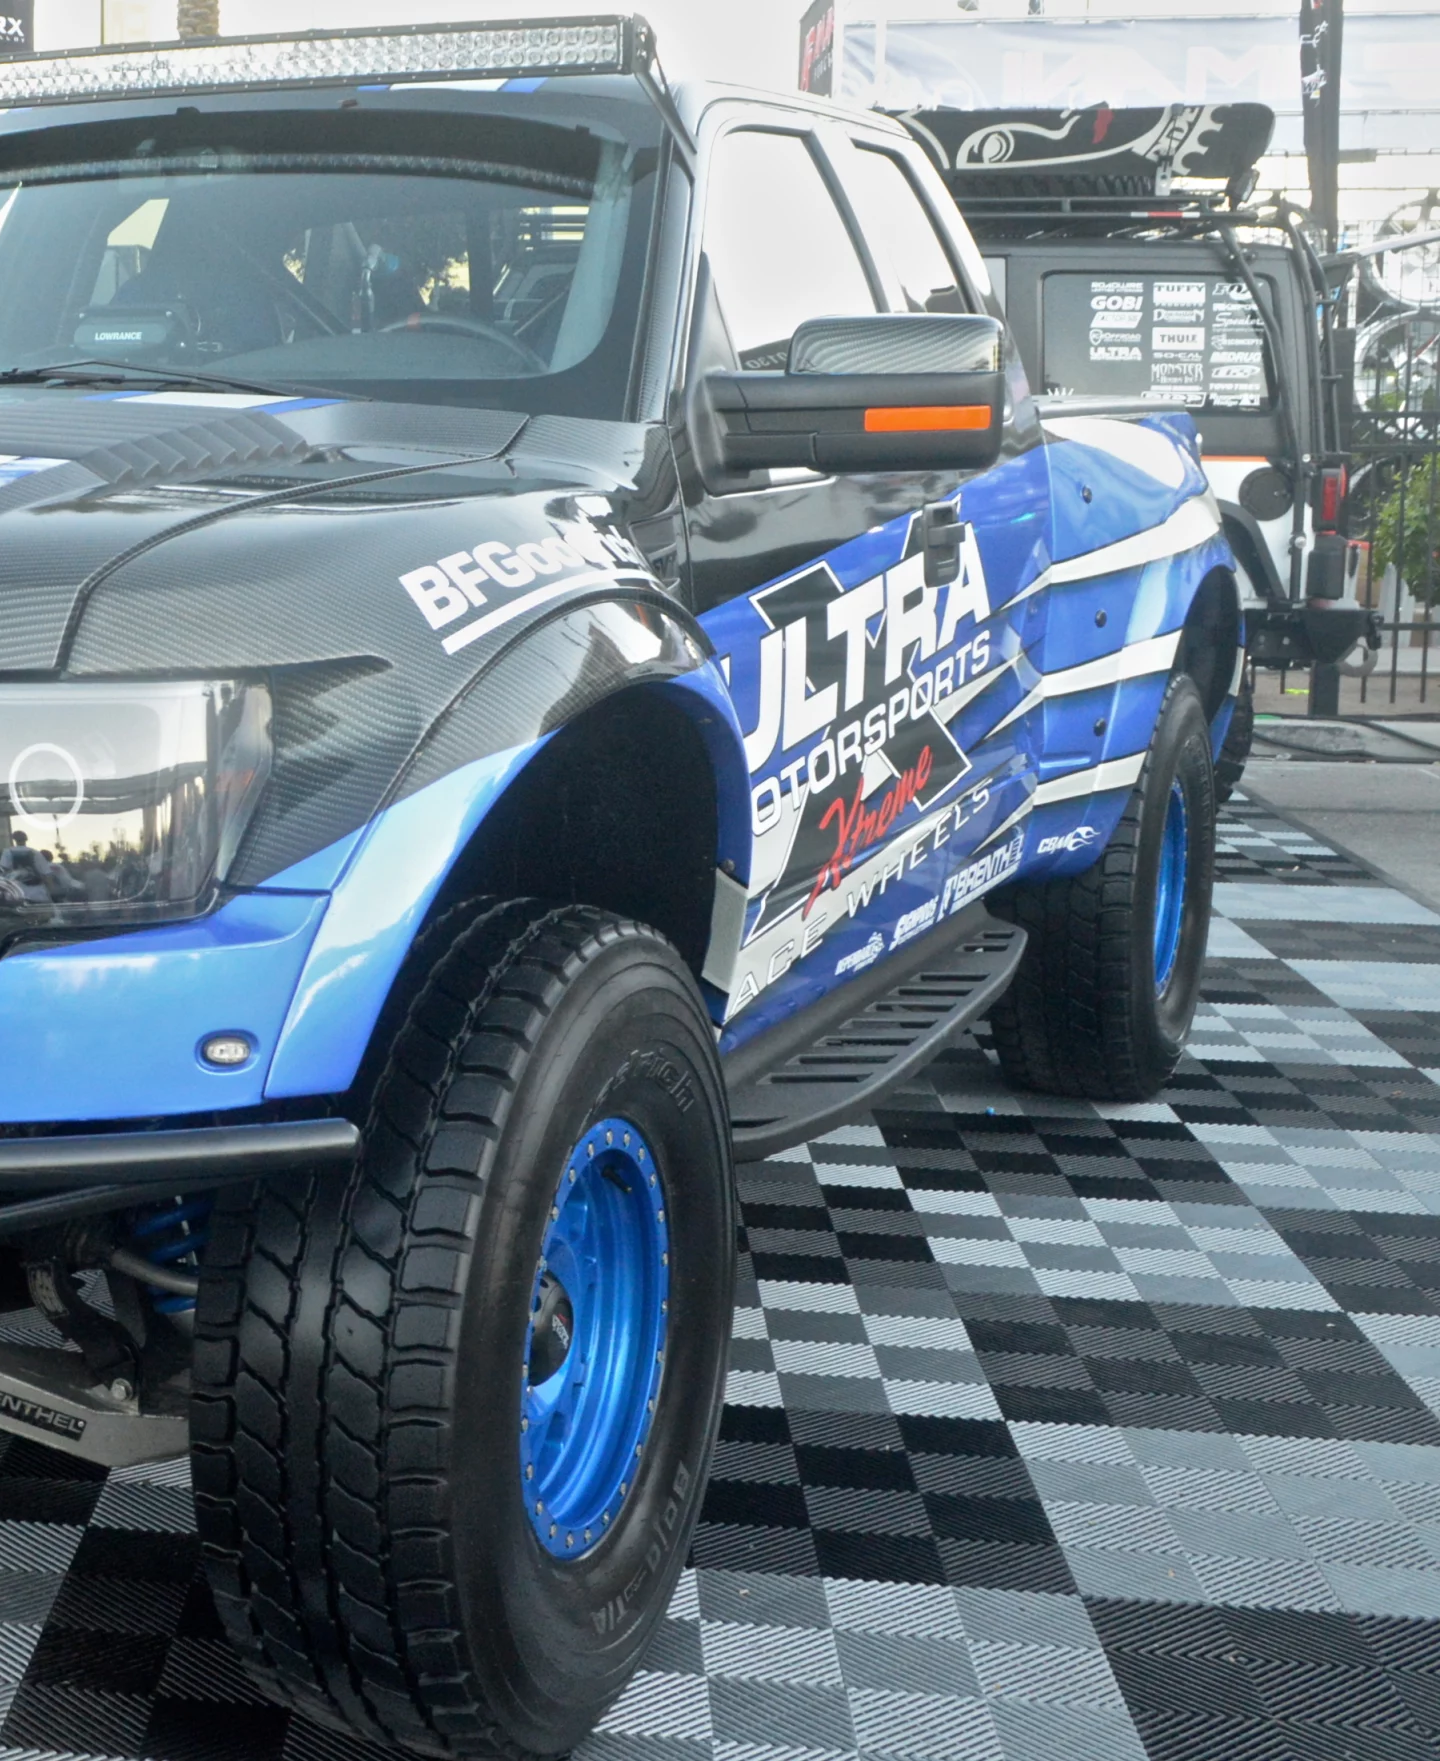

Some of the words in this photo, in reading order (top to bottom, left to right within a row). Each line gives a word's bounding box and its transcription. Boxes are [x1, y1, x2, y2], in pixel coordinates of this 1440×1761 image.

[1155, 284, 1205, 293] TUFFY
[1090, 295, 1143, 311] GOBI
[94, 331, 142, 341] LOWRANCE
[1160, 334, 1197, 343] THULE
[1090, 347, 1142, 358] ULTRA
[751, 628, 992, 837] OTORSPORTS
[801, 743, 933, 921] Xtreme
[726, 911, 827, 1022] ACE
[846, 778, 993, 921] WHEELS
